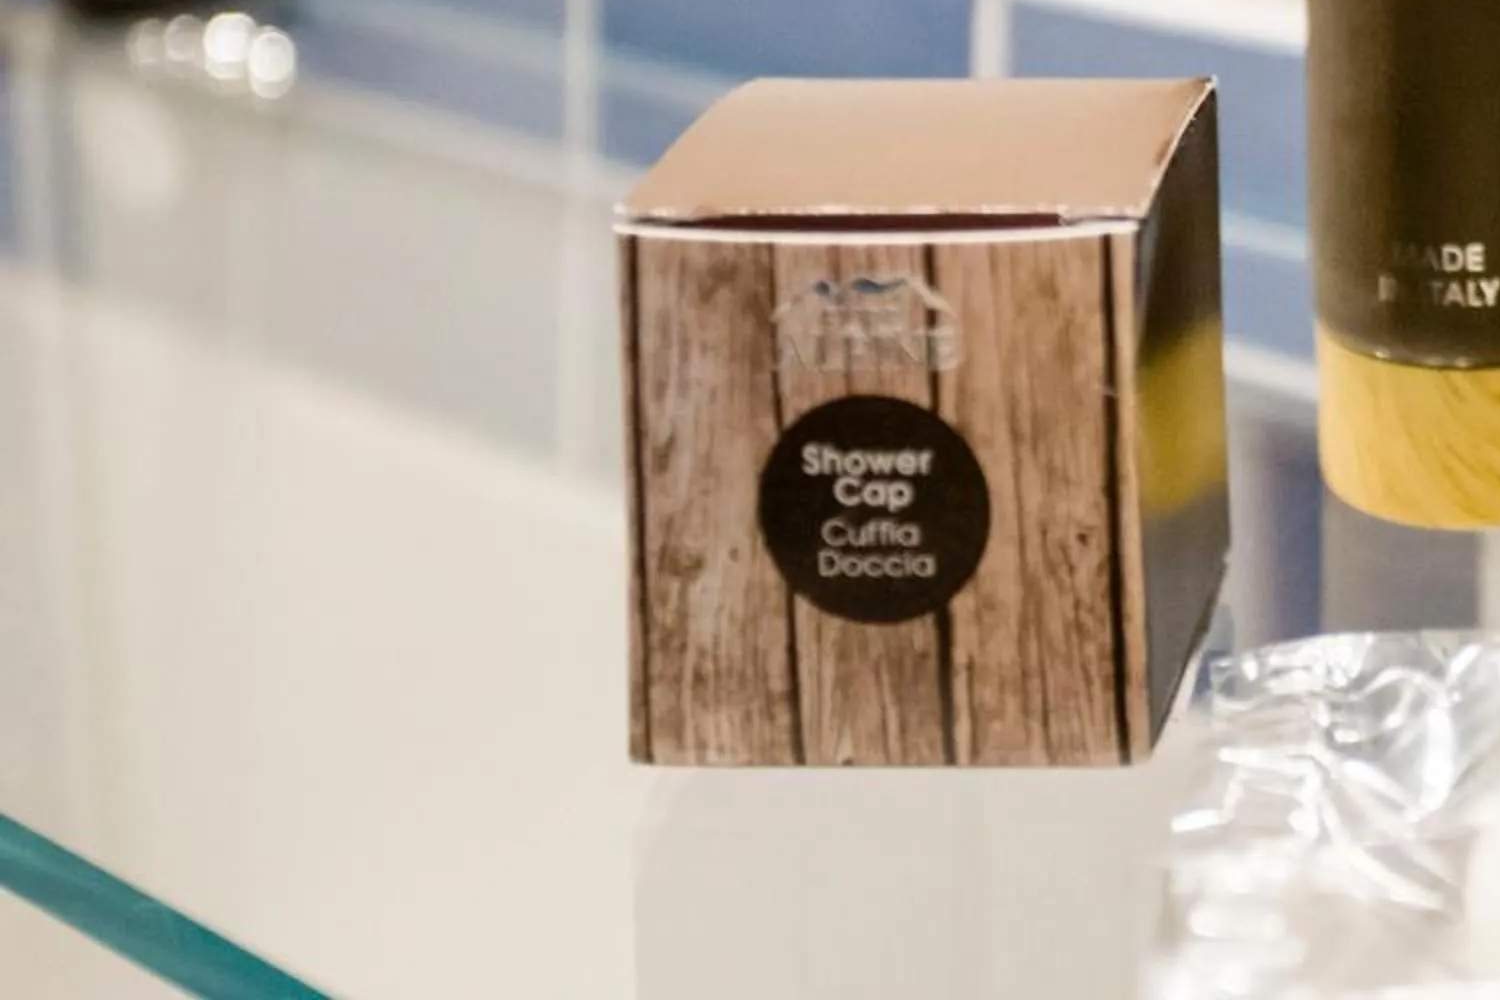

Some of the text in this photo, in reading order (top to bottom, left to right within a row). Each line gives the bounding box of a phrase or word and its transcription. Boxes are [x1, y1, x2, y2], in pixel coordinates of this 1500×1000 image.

[1392, 241, 1487, 273] ADE
[800, 441, 934, 477] Shower
[833, 477, 914, 512] Cap
[820, 516, 923, 548] Cuffia
[816, 550, 937, 578] Doccia
